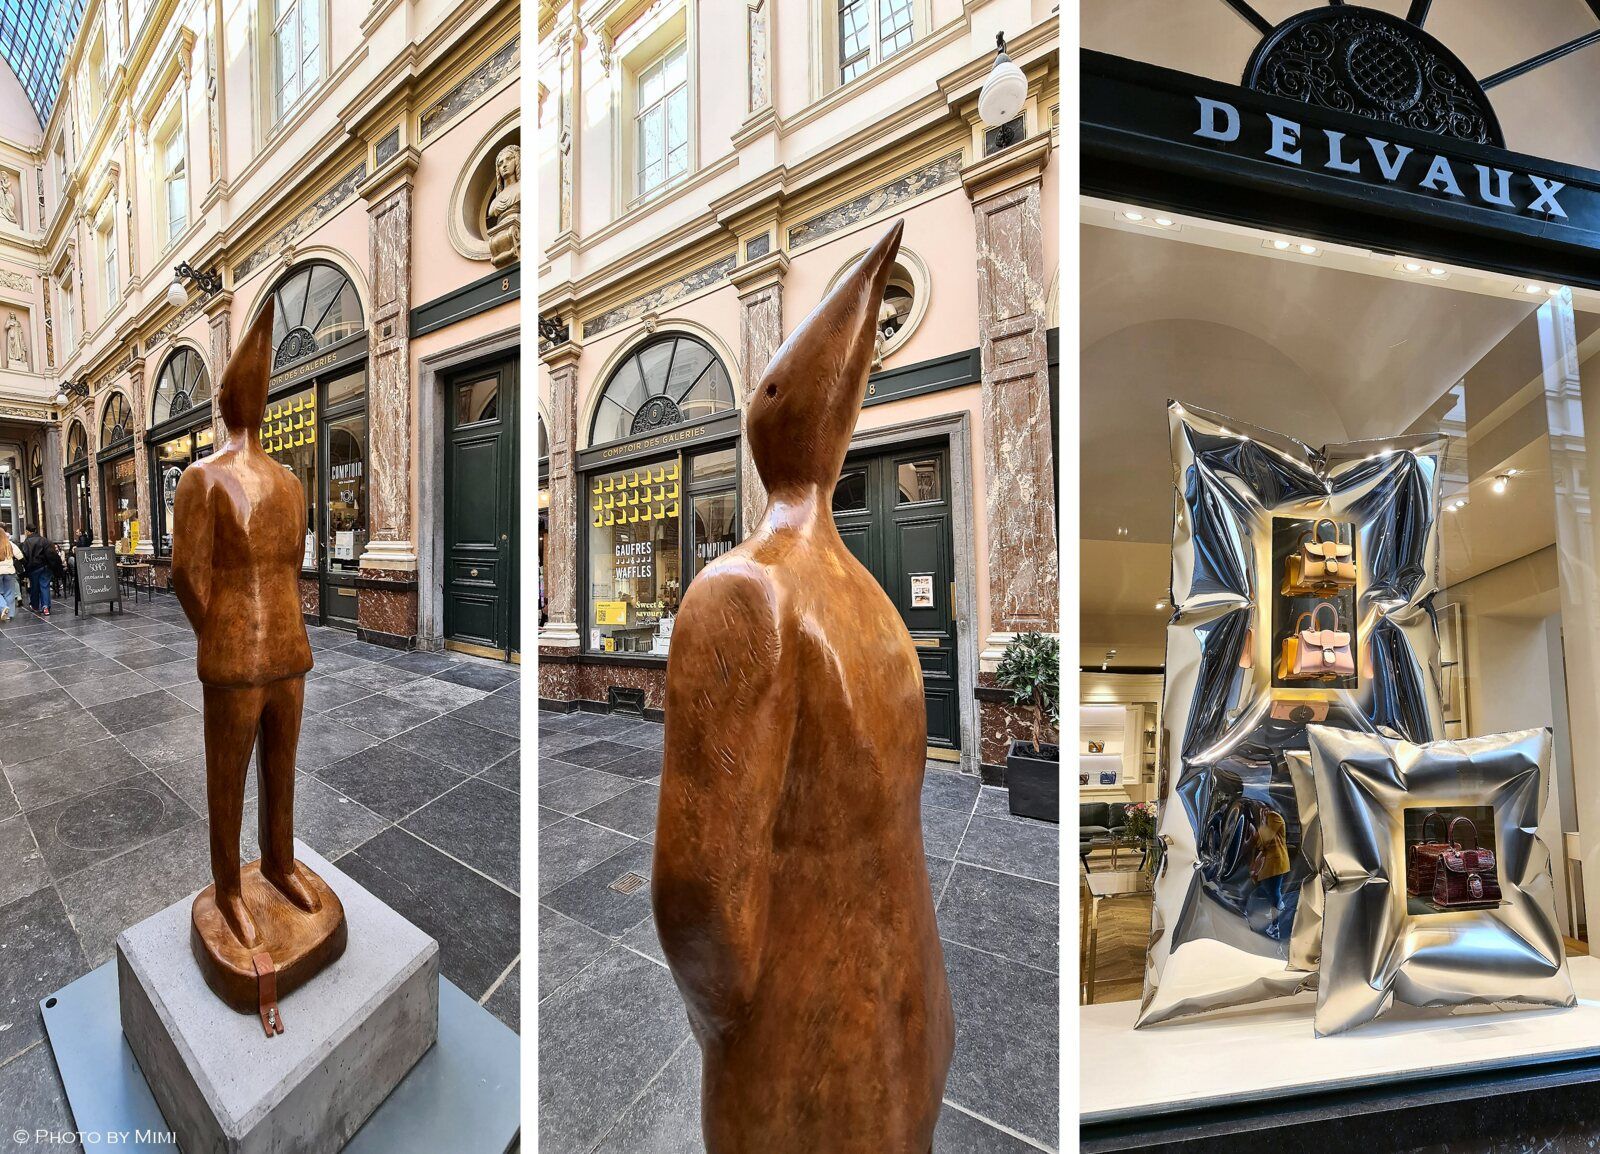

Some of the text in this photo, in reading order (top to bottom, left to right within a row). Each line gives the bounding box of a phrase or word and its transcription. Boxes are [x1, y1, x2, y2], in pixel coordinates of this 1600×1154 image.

[1193, 96, 1570, 221] DELVAUX
[502, 278, 509, 291] 8
[291, 342, 296, 350] 6
[284, 353, 337, 381] DES GALERIES
[869, 384, 876, 395] 8
[652, 409, 657, 418] 6
[602, 427, 706, 458] COMPTOIR DES GALERIES
[331, 462, 362, 480] COMPTOIR
[615, 542, 652, 557] GAUFRES
[615, 566, 652, 579] WAFFLES
[635, 600, 666, 609] Sweet &
[635, 610, 664, 618] savoury
